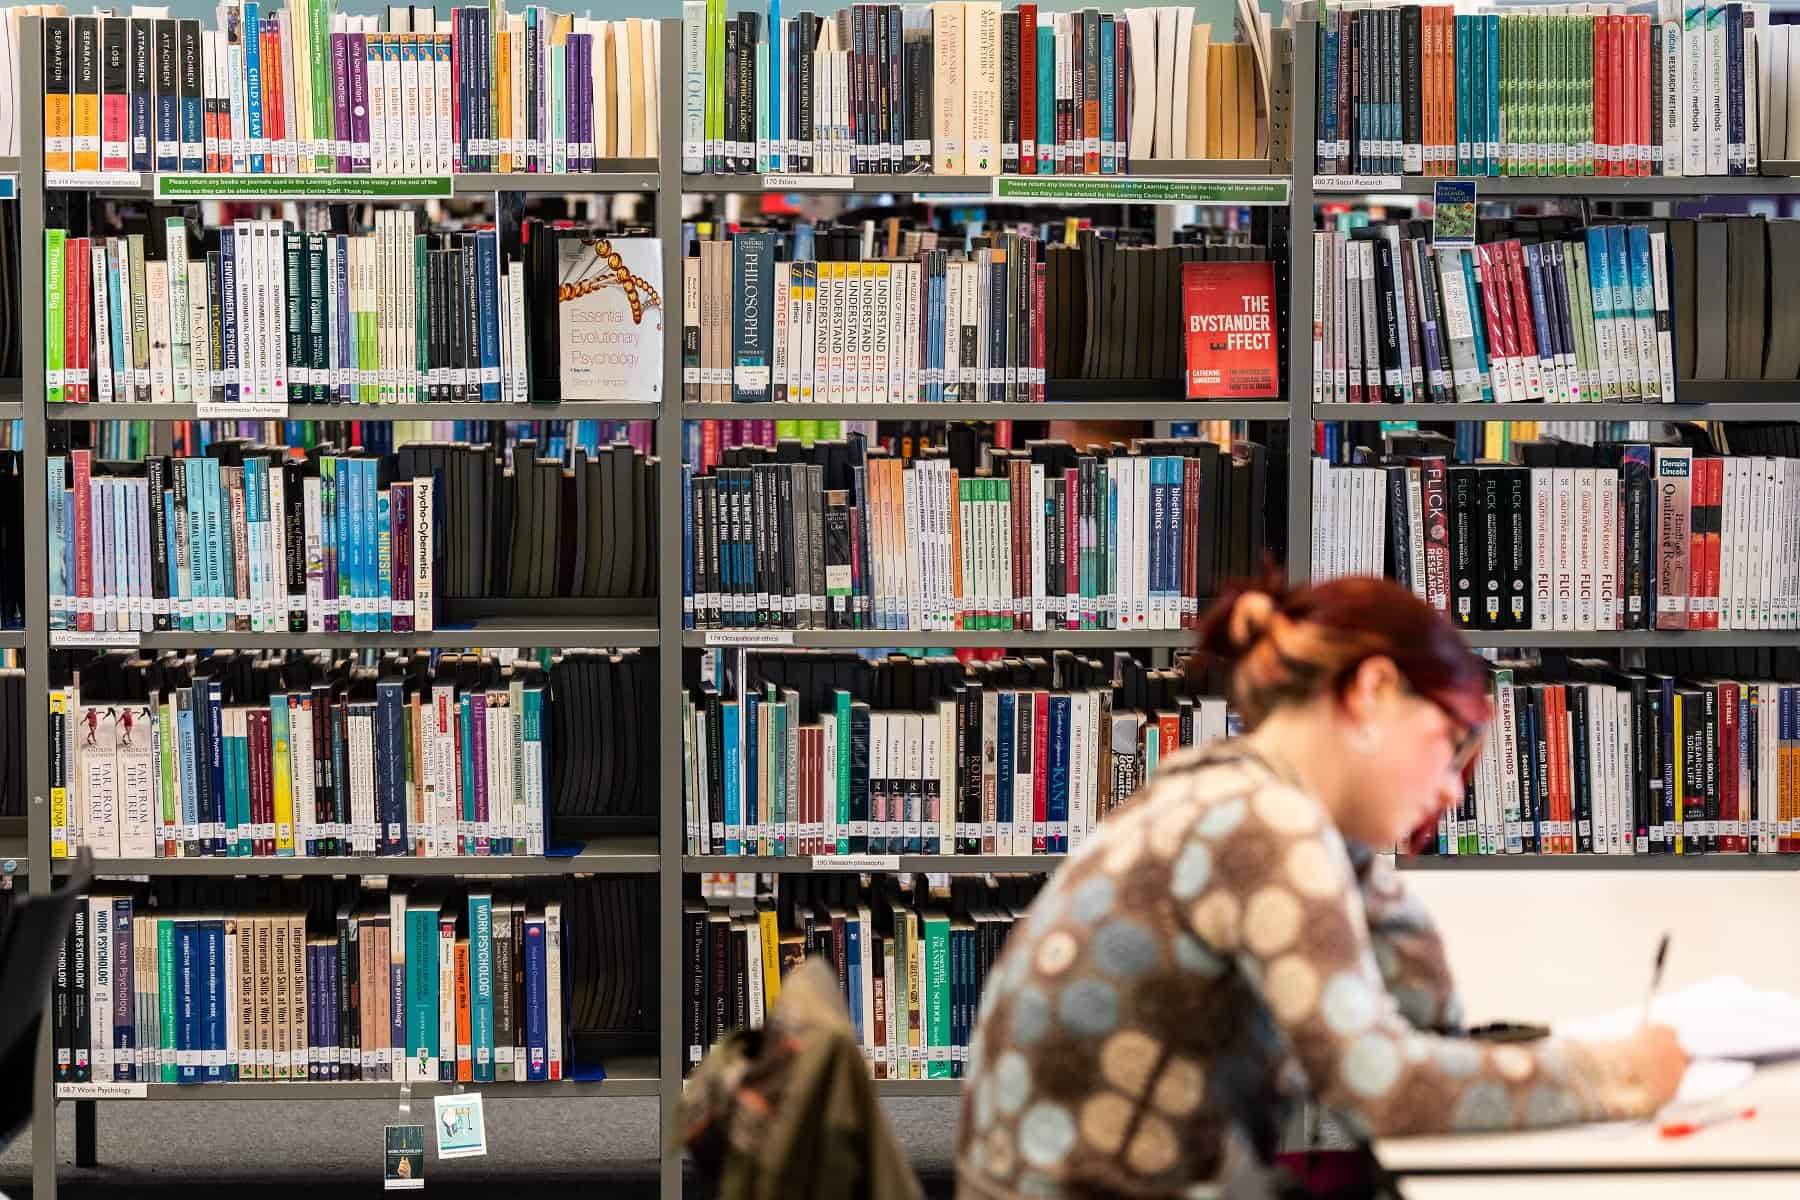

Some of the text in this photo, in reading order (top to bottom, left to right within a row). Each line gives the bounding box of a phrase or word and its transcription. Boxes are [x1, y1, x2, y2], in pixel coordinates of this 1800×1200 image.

[729, 30, 737, 49] Logic
[949, 25, 957, 85] COMPANION
[1668, 29, 1676, 53] SOCIAL
[336, 40, 346, 108] why love matters
[250, 68, 261, 137] CHILD'S PLAY
[135, 292, 145, 332] AFFLUENZA
[224, 261, 234, 326] ENVIRONMENTAL
[257, 285, 265, 332] ENVIRONMENTAL
[570, 310, 624, 323] Essential
[744, 254, 758, 347] PHILOSOPHY
[778, 281, 786, 327] JUSTICE
[818, 281, 828, 353] UNDERSTAND
[833, 282, 843, 354] UNDERSTAND
[847, 281, 857, 353] UNDERSTAND
[863, 280, 872, 352] UNDERSTAND
[877, 280, 887, 352] UNDERSTAND
[1242, 296, 1269, 312] THE
[571, 329, 639, 346] Evolutionary
[1190, 314, 1270, 332] BYSTANDER
[571, 350, 639, 368] Psychology
[1662, 459, 1686, 467] Denzin
[1154, 488, 1163, 529] bioethics
[1171, 488, 1180, 529] bioethics
[1428, 469, 1443, 519] FLICK
[1458, 479, 1468, 508] FLICK
[1487, 480, 1496, 509] FLICK
[191, 512, 200, 581] ANIMAL BEHAVIOUR
[208, 512, 217, 581] ANIMAL BEHAVIOUR
[307, 535, 320, 583] FLOW
[378, 531, 389, 582] MINDSET
[418, 485, 429, 579] Psycho-Cybernetics
[1675, 514, 1684, 570] Handbook of
[1502, 687, 1513, 775] RESEARCH METHODS
[91, 767, 103, 822] THE TREE
[103, 763, 112, 824] FAR FROM
[127, 767, 137, 822] THE TREE
[138, 763, 148, 823] FAR FROM
[971, 755, 981, 799] RORTY
[1052, 767, 1063, 815] KANT
[1125, 754, 1134, 796] Deleuze
[1538, 741, 1548, 797] Action Research
[1523, 780, 1531, 817] Research
[75, 912, 84, 989] WORK PSYCHOLOGY
[97, 910, 108, 986] WORK PSYCHOLOGY
[478, 905, 489, 997] WORK PSYCHOLOGY
[694, 920, 702, 996] The Power of Ideas
[114, 942, 129, 1017] Work Psychology
[240, 928, 251, 1025] Interpersonal Skills at Work
[257, 928, 269, 1025] Interpersonal Skills at Work
[275, 928, 286, 1025] Interpersonal Skills at Work
